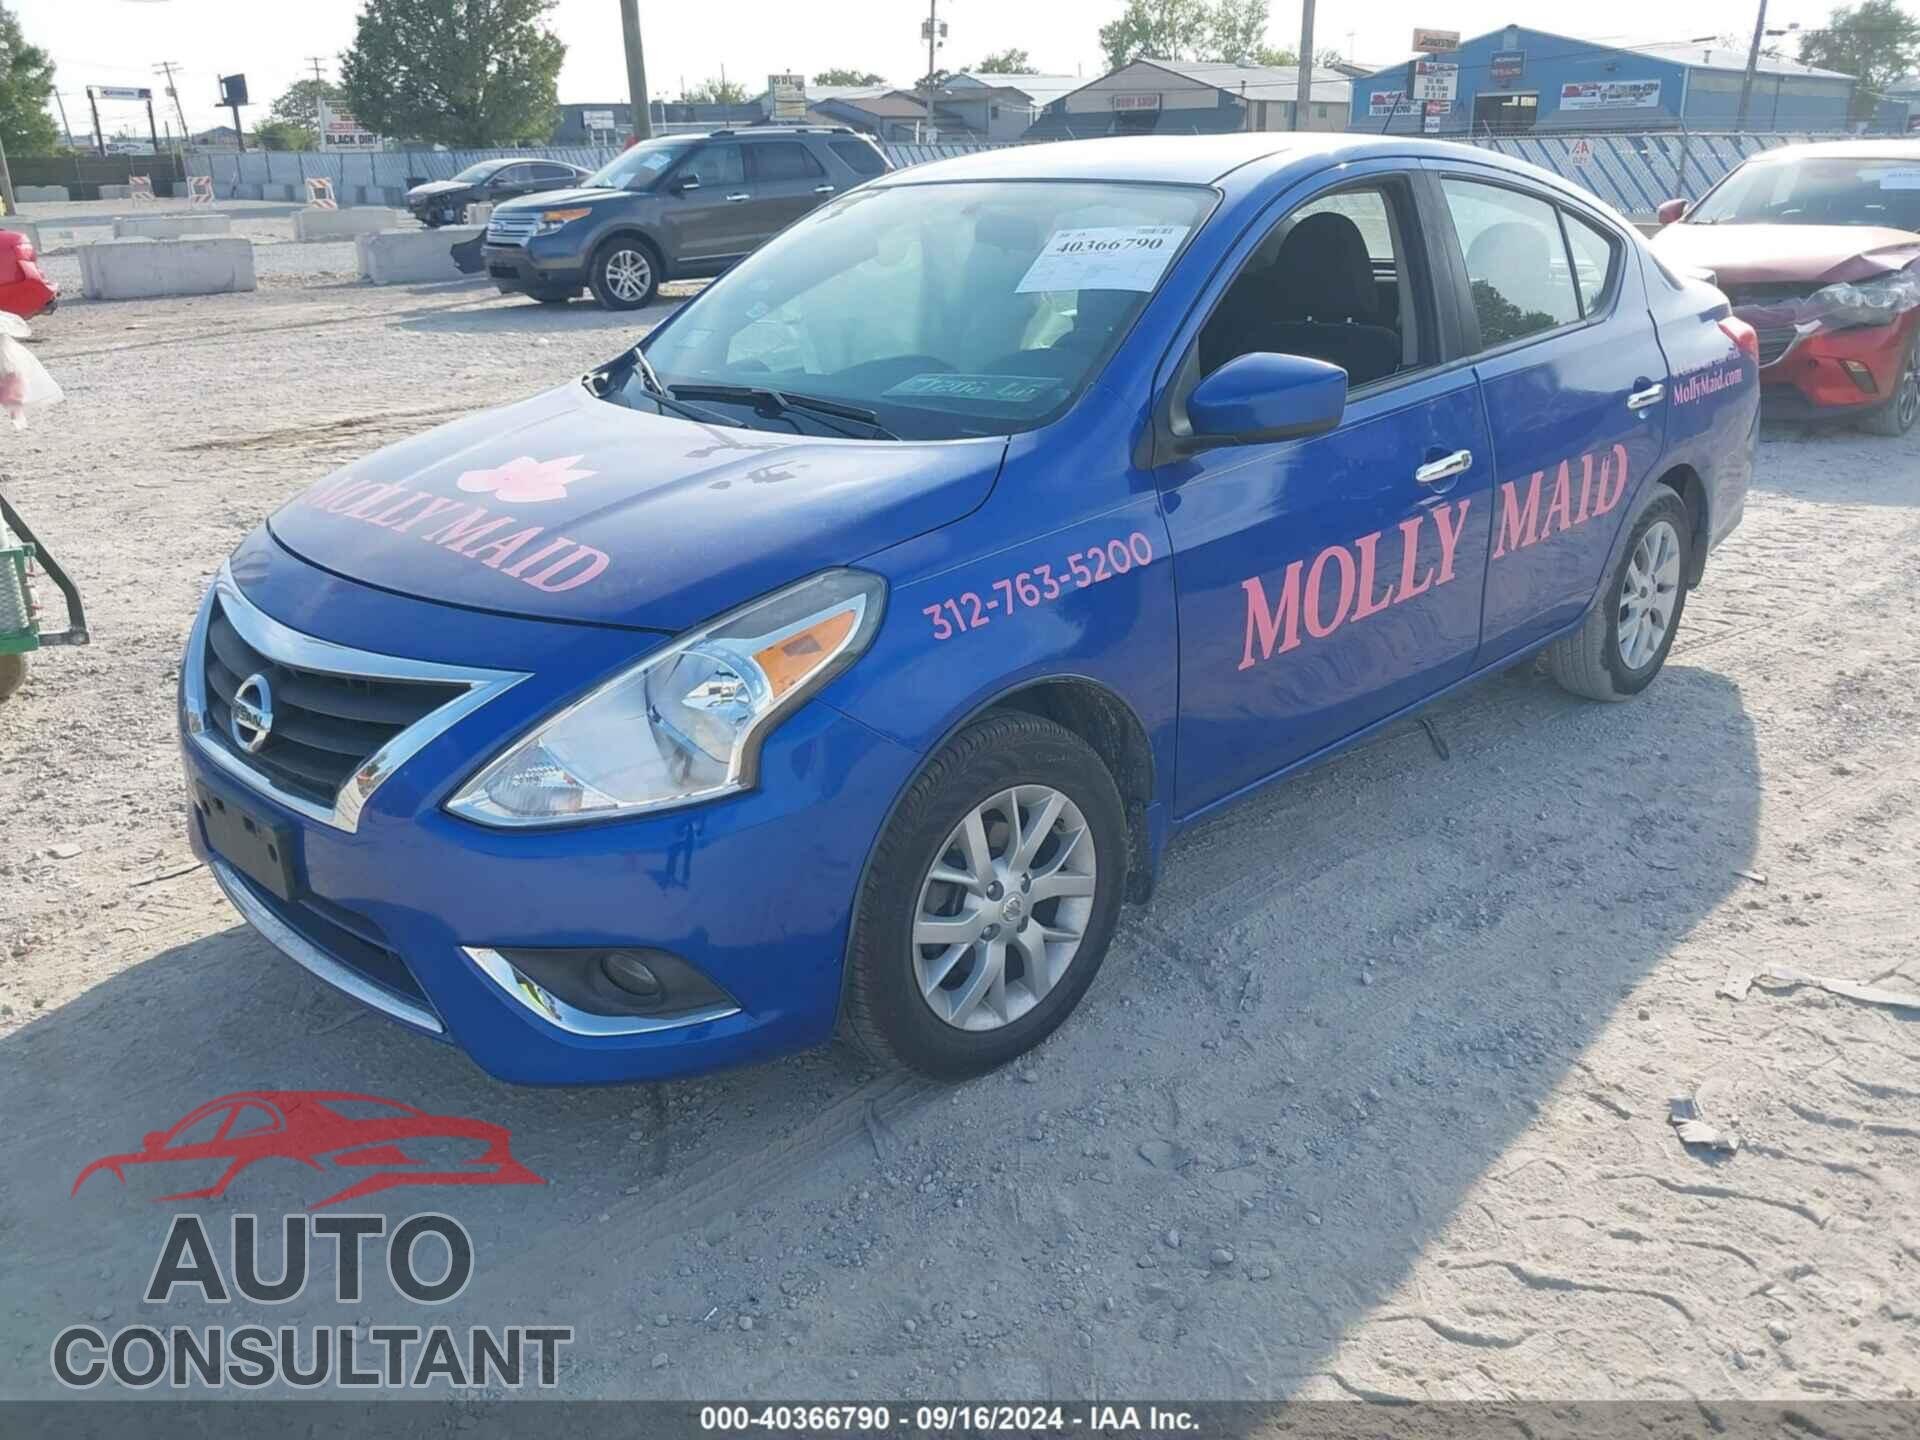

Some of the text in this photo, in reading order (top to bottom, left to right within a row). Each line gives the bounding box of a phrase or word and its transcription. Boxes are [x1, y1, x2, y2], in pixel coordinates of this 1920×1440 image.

[1056, 237, 1164, 253] 40366790
[1672, 368, 1743, 407] MollyMaid.com
[421, 505, 610, 592] MAID
[923, 532, 1153, 640] 312-763-5200
[1238, 444, 1628, 671] MOLLY MAID
